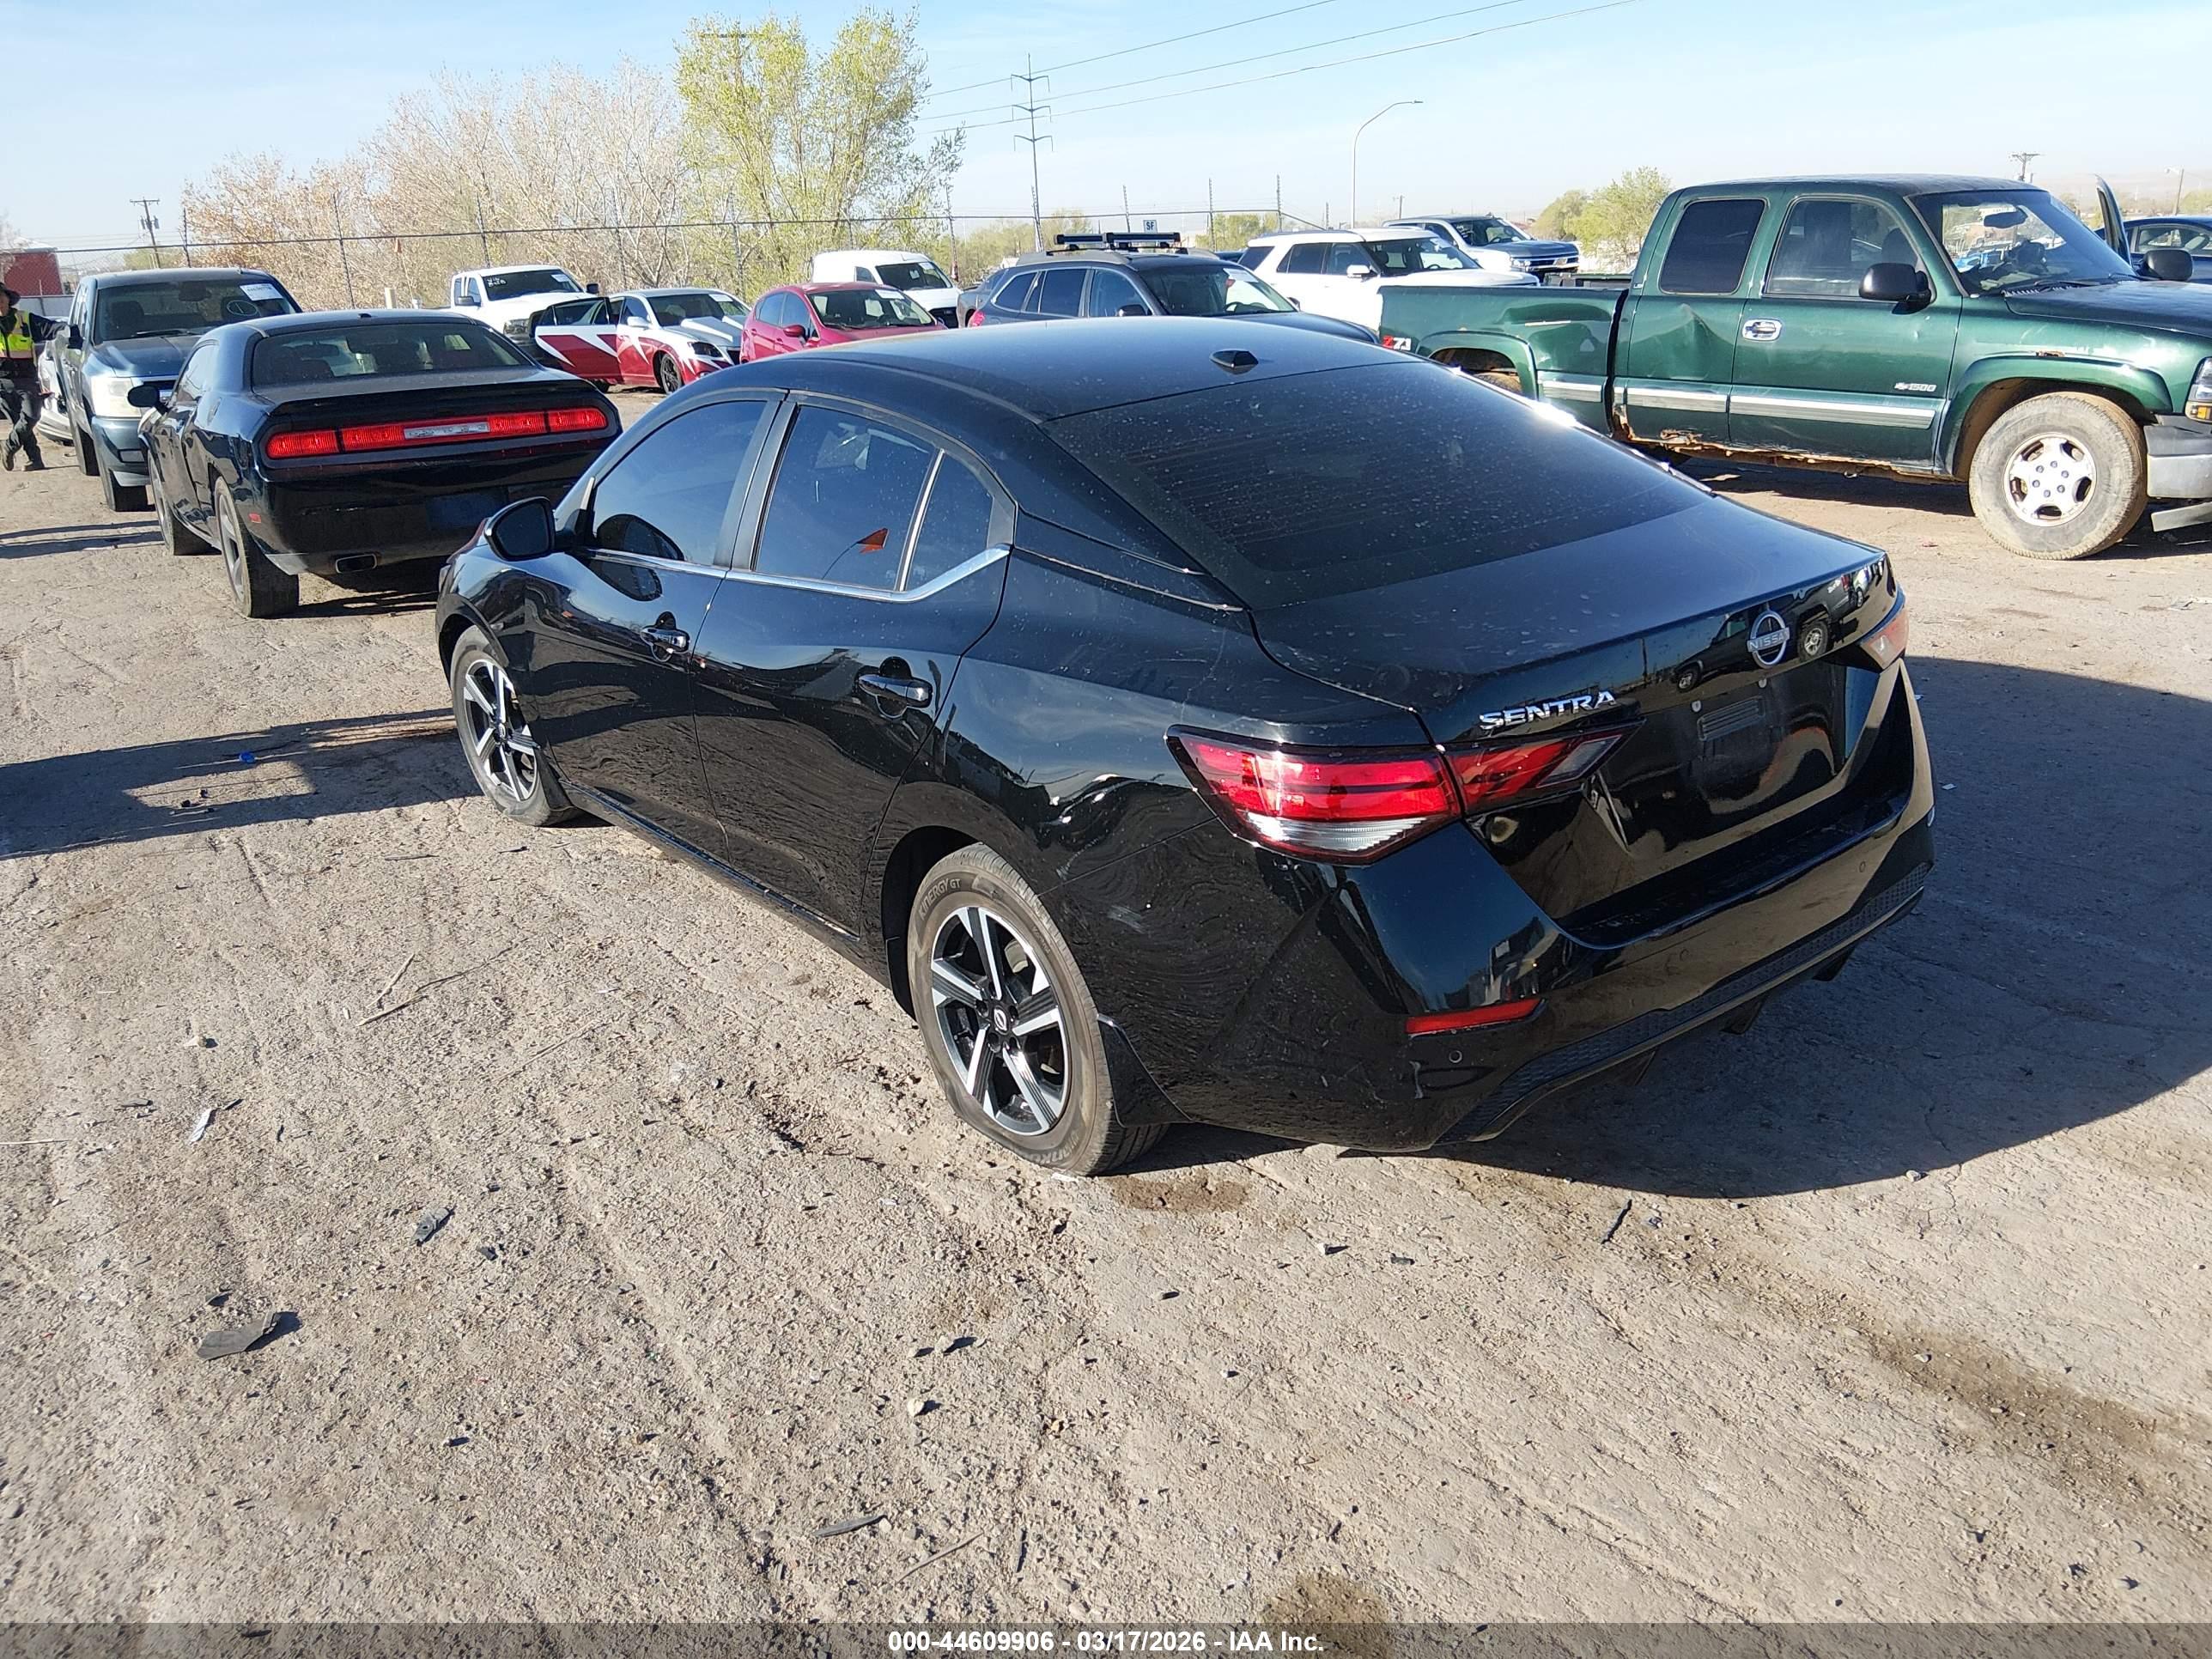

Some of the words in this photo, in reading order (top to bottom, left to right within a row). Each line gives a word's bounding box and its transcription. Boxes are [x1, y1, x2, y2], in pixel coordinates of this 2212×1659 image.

[1146, 221, 1155, 231] SF
[1382, 335, 1413, 351] Z71
[1908, 382, 1937, 392] 1500
[1479, 690, 1617, 730] SENTRA
[950, 878, 961, 889] GT
